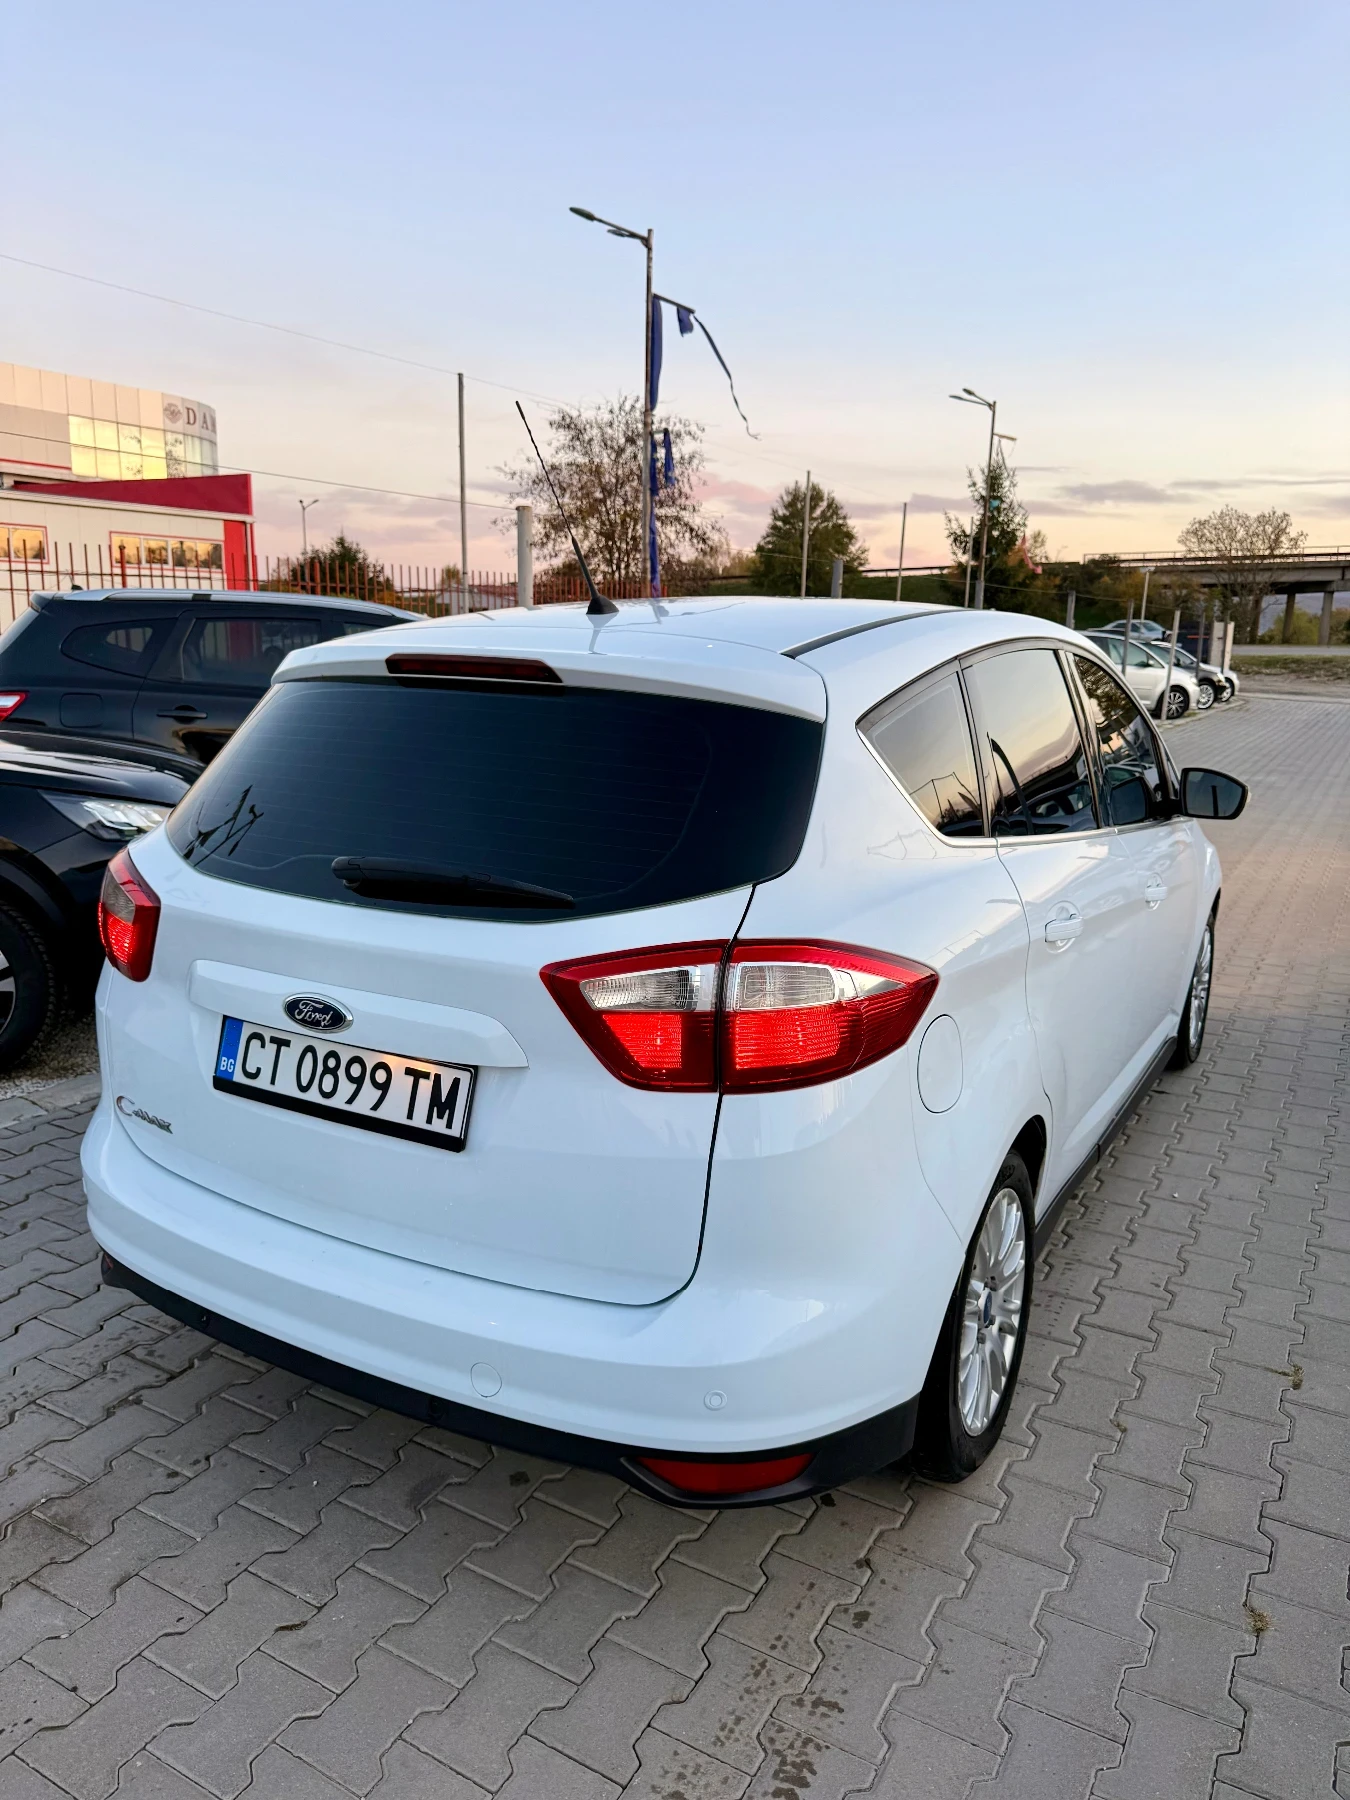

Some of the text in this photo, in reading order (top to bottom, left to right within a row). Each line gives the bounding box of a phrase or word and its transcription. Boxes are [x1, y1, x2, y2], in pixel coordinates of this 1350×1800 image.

[294, 1000, 334, 1027] Ford
[220, 1056, 235, 1073] BG
[241, 1031, 461, 1130] CT 0899 TM
